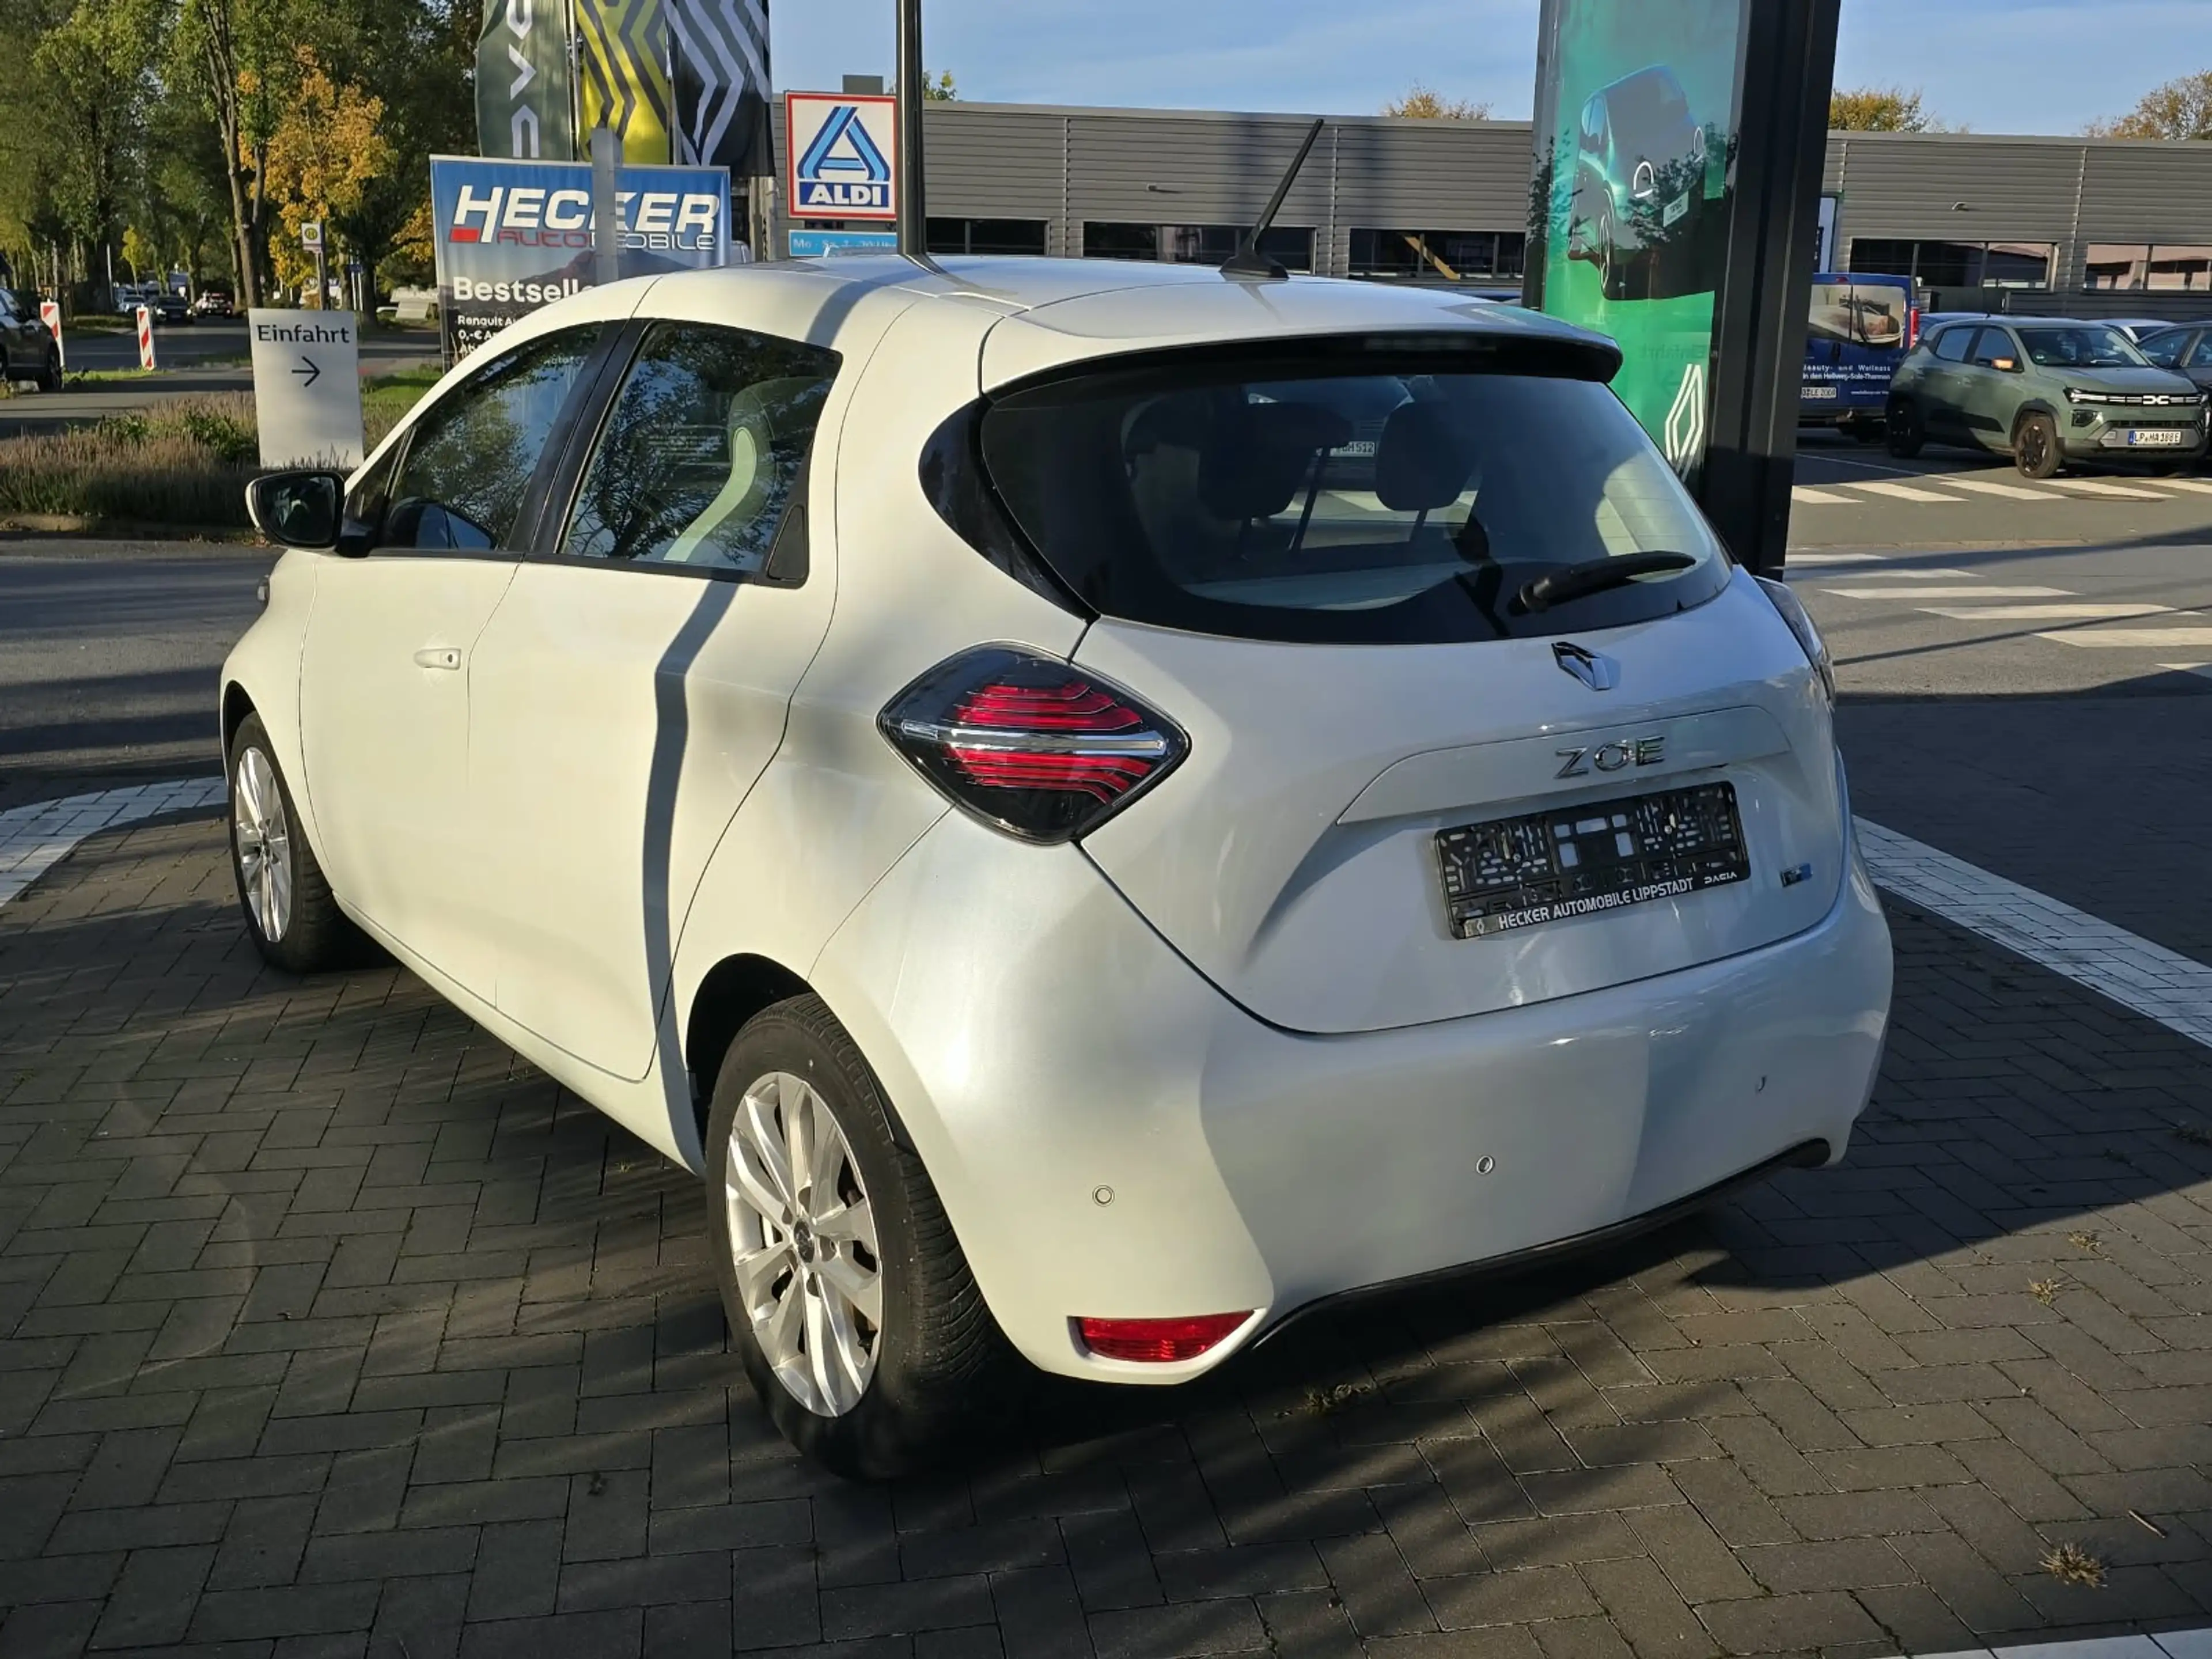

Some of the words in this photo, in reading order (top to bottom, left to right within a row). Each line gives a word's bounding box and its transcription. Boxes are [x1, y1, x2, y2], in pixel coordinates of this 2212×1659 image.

[808, 184, 882, 206] ALDI
[497, 230, 716, 251] AUTOOBILE
[453, 276, 594, 303] Bestsell
[457, 315, 503, 326] Renault
[256, 324, 351, 343] Einfahrt
[1554, 736, 1665, 779] ZOE
[1498, 907, 1550, 930] HECKER
[1552, 890, 1631, 920] AUTOMOBILE
[1633, 877, 1694, 901] LIPPSTADT
[1703, 871, 1737, 884] DACIA
